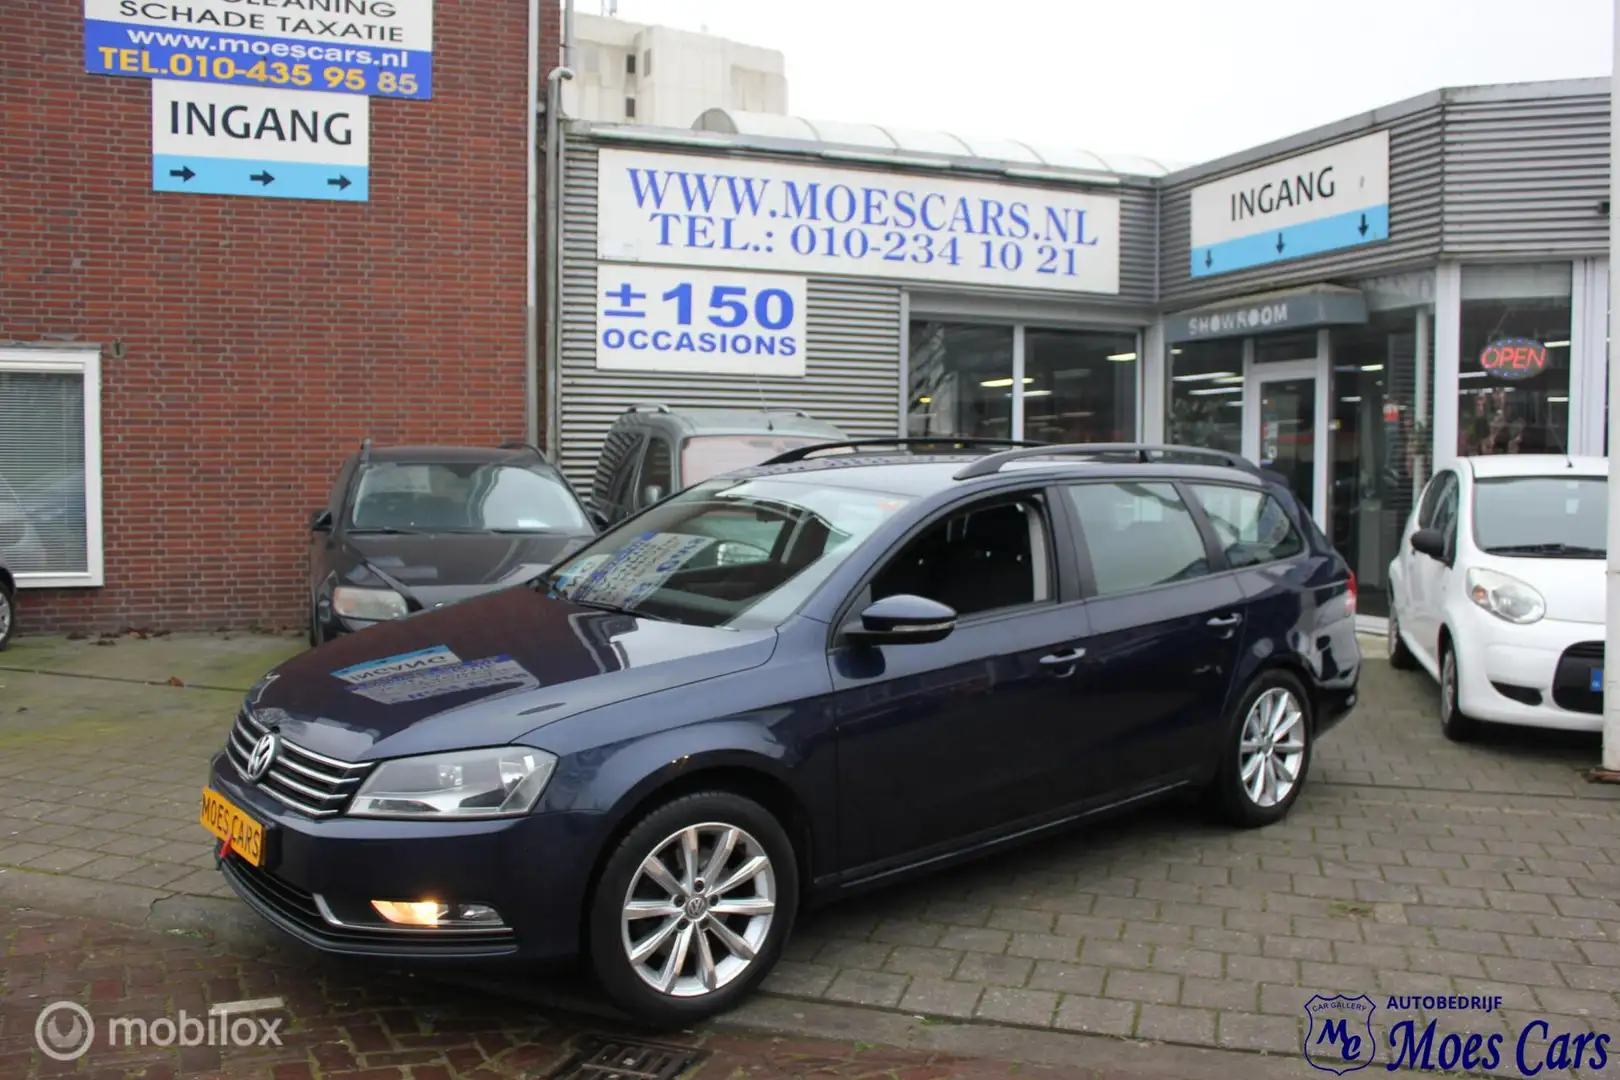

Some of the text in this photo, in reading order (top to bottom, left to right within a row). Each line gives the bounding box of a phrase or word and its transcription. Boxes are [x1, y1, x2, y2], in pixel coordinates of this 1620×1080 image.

[119, 0, 403, 42] SCHADE TAXATIE
[221, 0, 397, 17] ANING
[126, 28, 408, 67] www.moescars.nl
[98, 46, 418, 95] TEL.010-435 95 85
[170, 100, 352, 145] INGANG
[626, 168, 1098, 246] WWW.MOESCARS.NL
[1230, 166, 1336, 222] INGANG
[649, 212, 1078, 277] TEL.: 010-234 10 21
[1187, 303, 1288, 336] SHOWROOM
[602, 328, 797, 357] OCCASIONS
[1481, 346, 1547, 369] OPEN
[202, 793, 260, 857] MOES CARS
